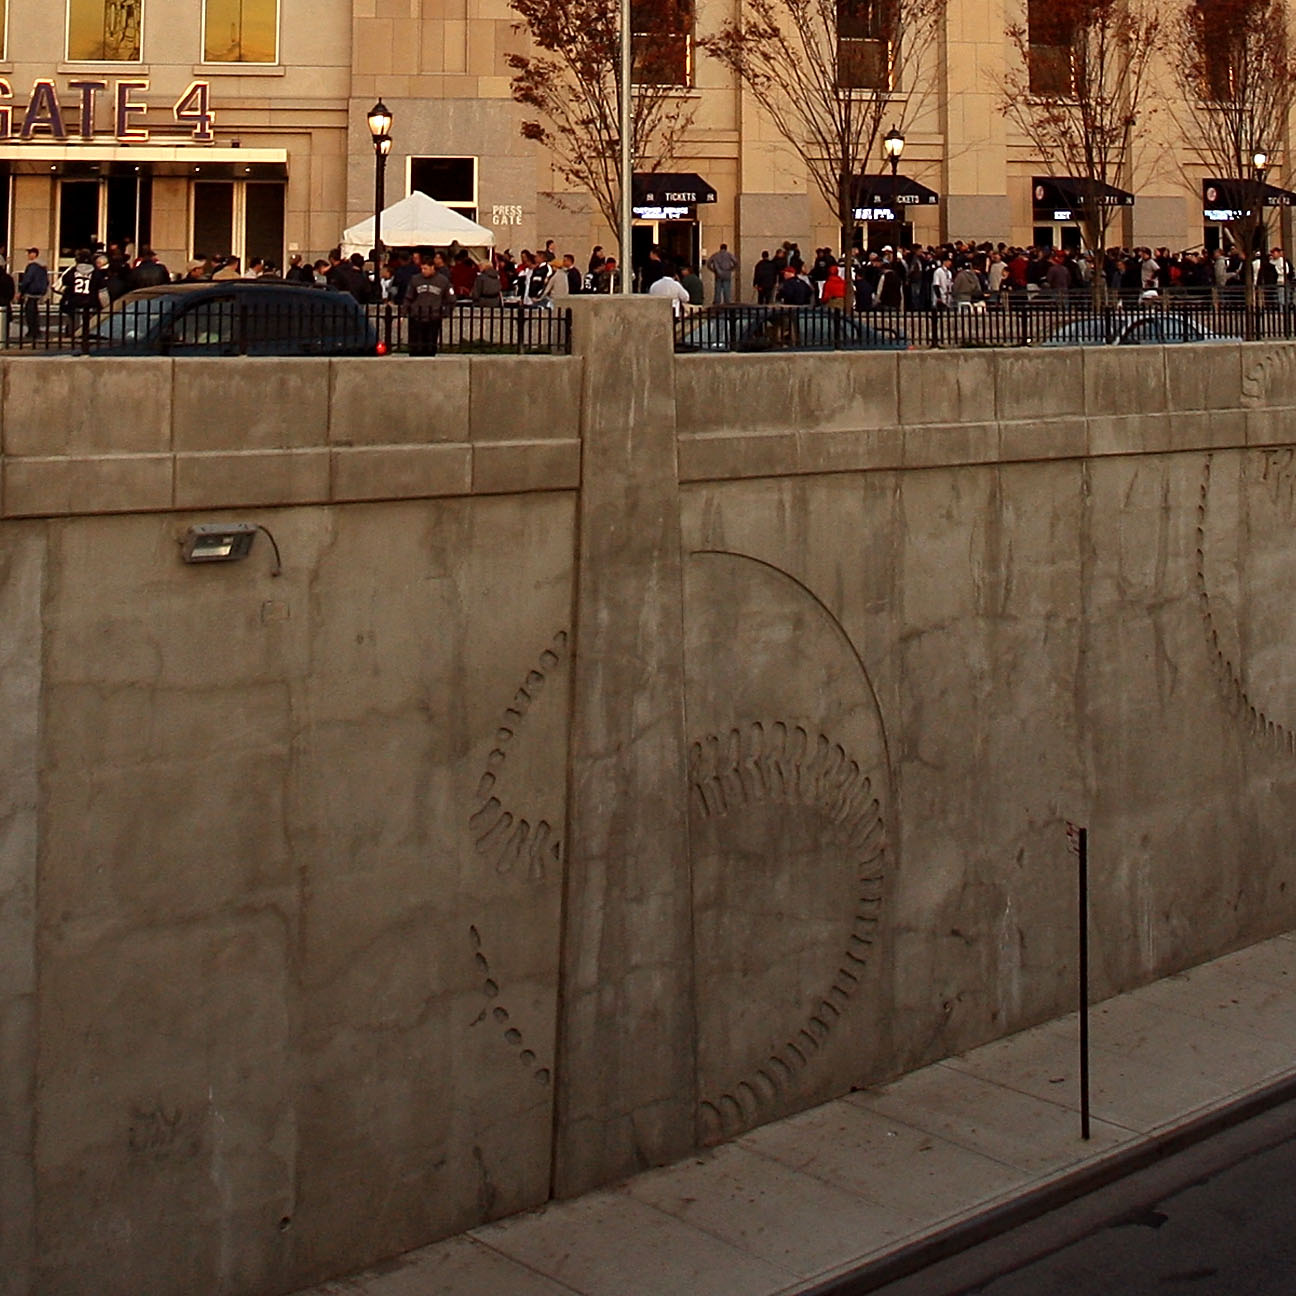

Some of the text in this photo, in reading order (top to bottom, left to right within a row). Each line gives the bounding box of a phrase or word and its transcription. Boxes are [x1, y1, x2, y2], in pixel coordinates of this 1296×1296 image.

[173, 80, 215, 143] 4
[665, 192, 697, 202] TICKETS
[492, 205, 522, 215] PRESS
[492, 215, 522, 225] GATE
[74, 278, 90, 294] 21
